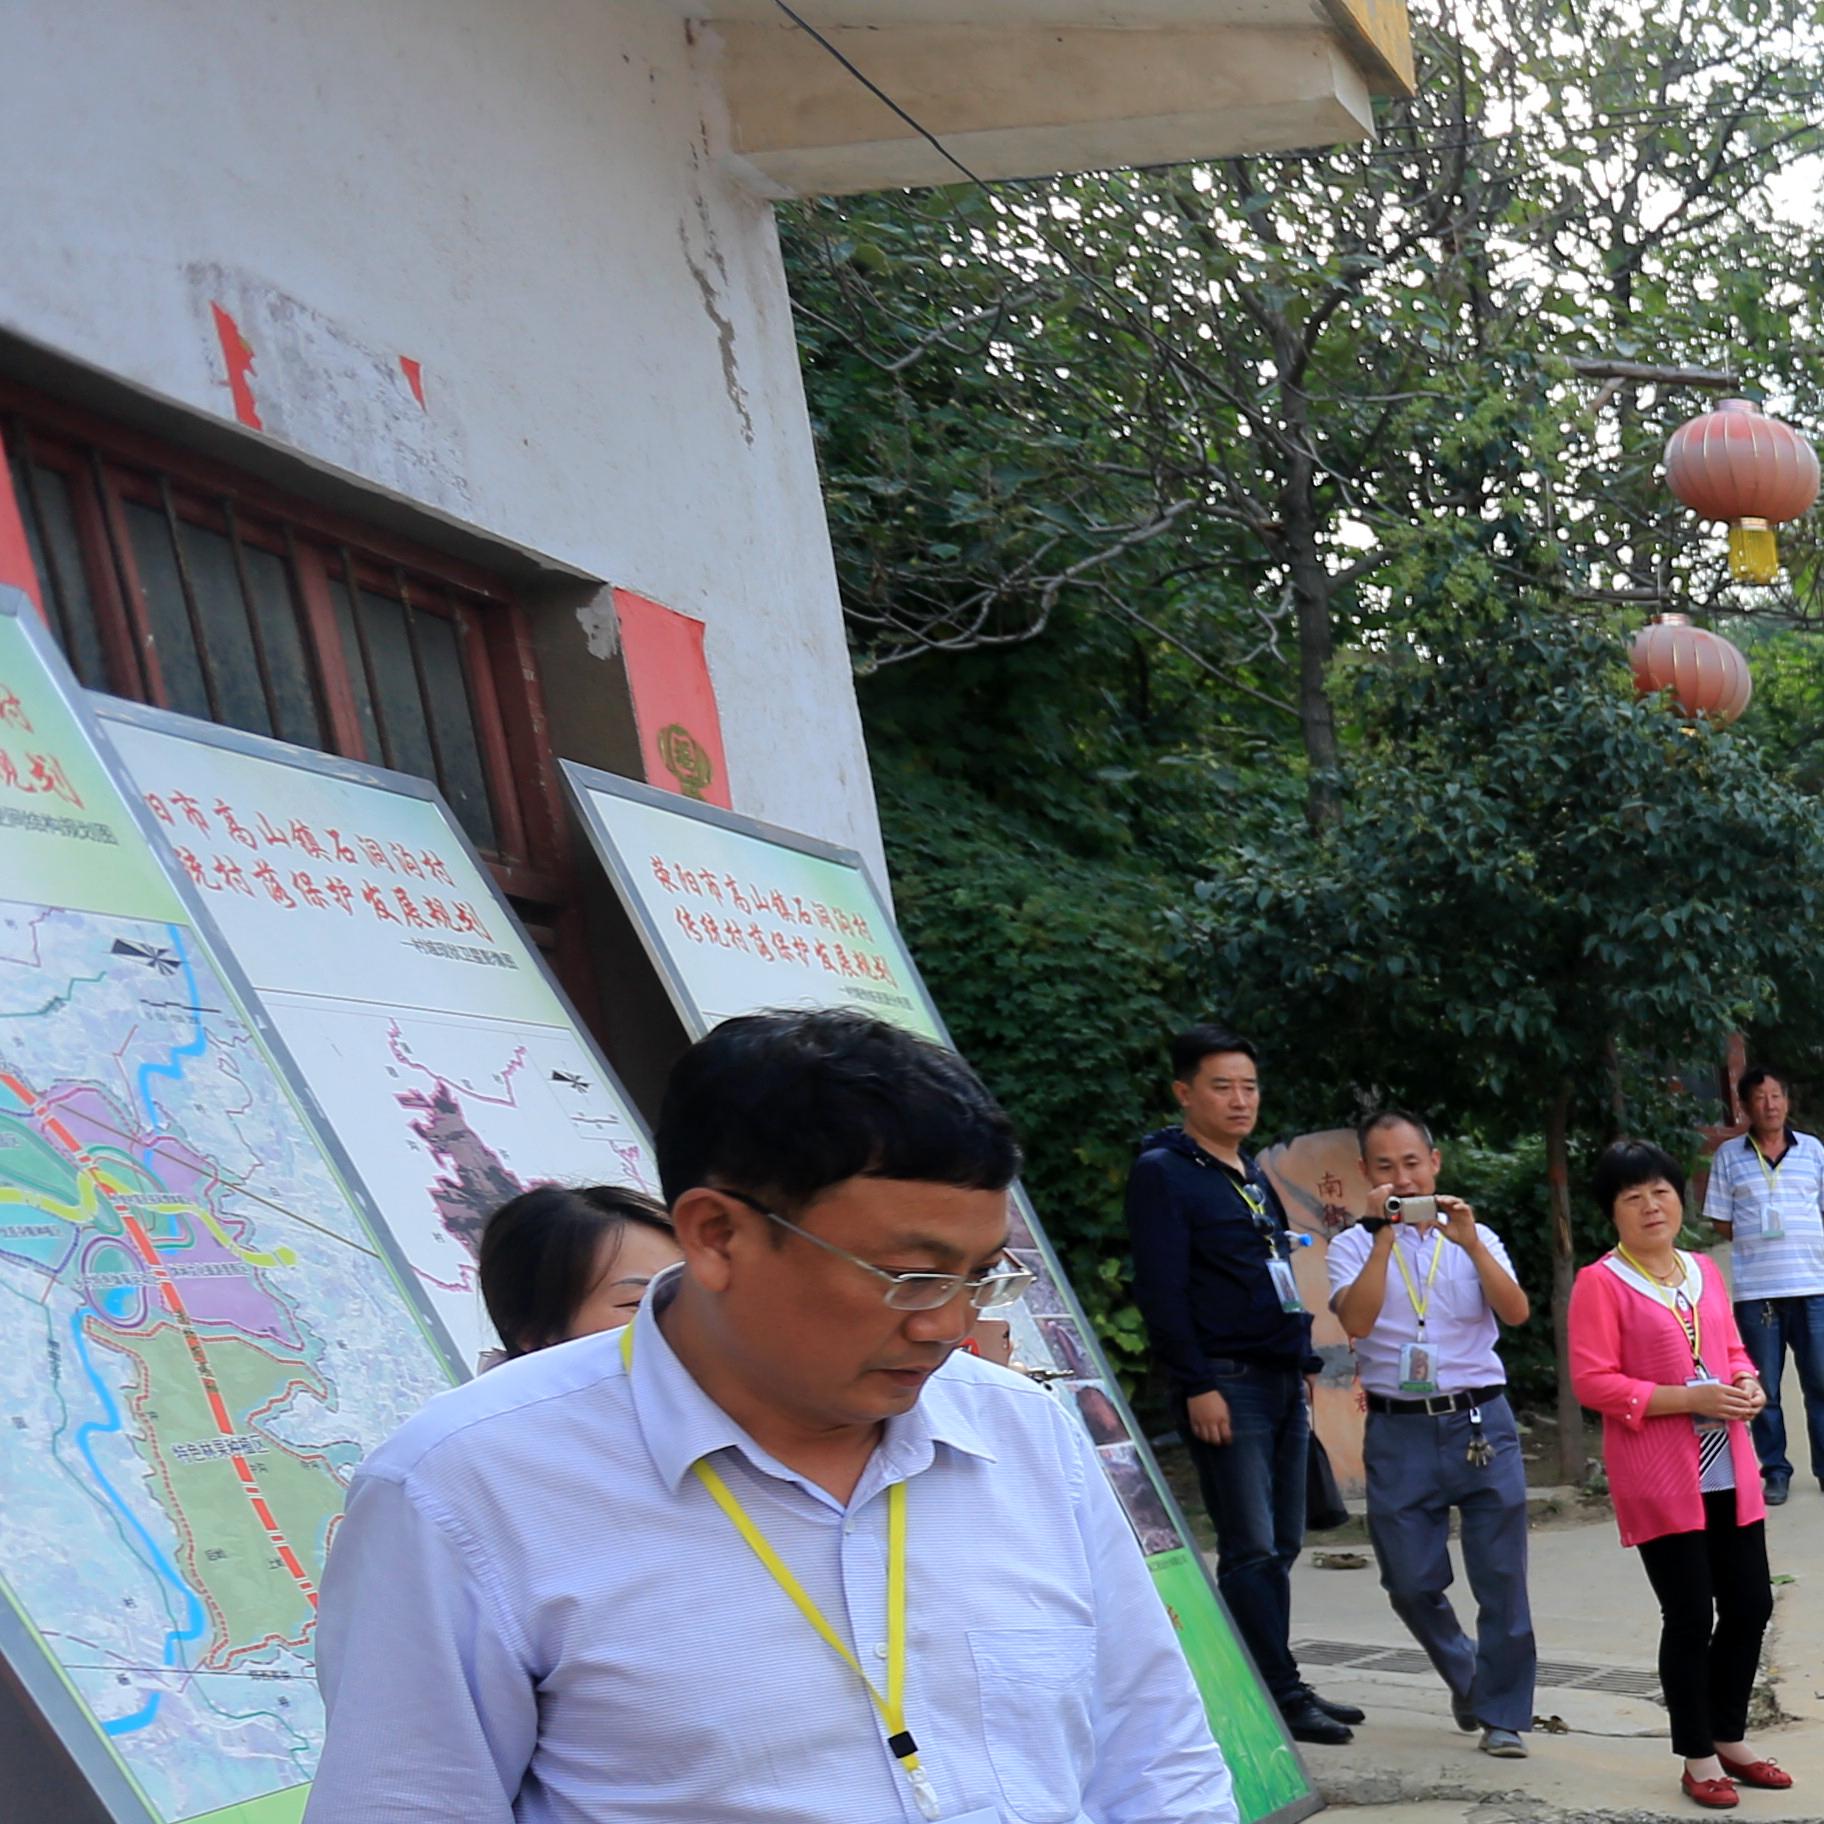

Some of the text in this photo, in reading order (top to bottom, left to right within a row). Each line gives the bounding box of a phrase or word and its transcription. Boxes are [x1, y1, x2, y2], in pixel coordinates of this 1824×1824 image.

[675, 904, 899, 989] 传统村落保护发展规划
